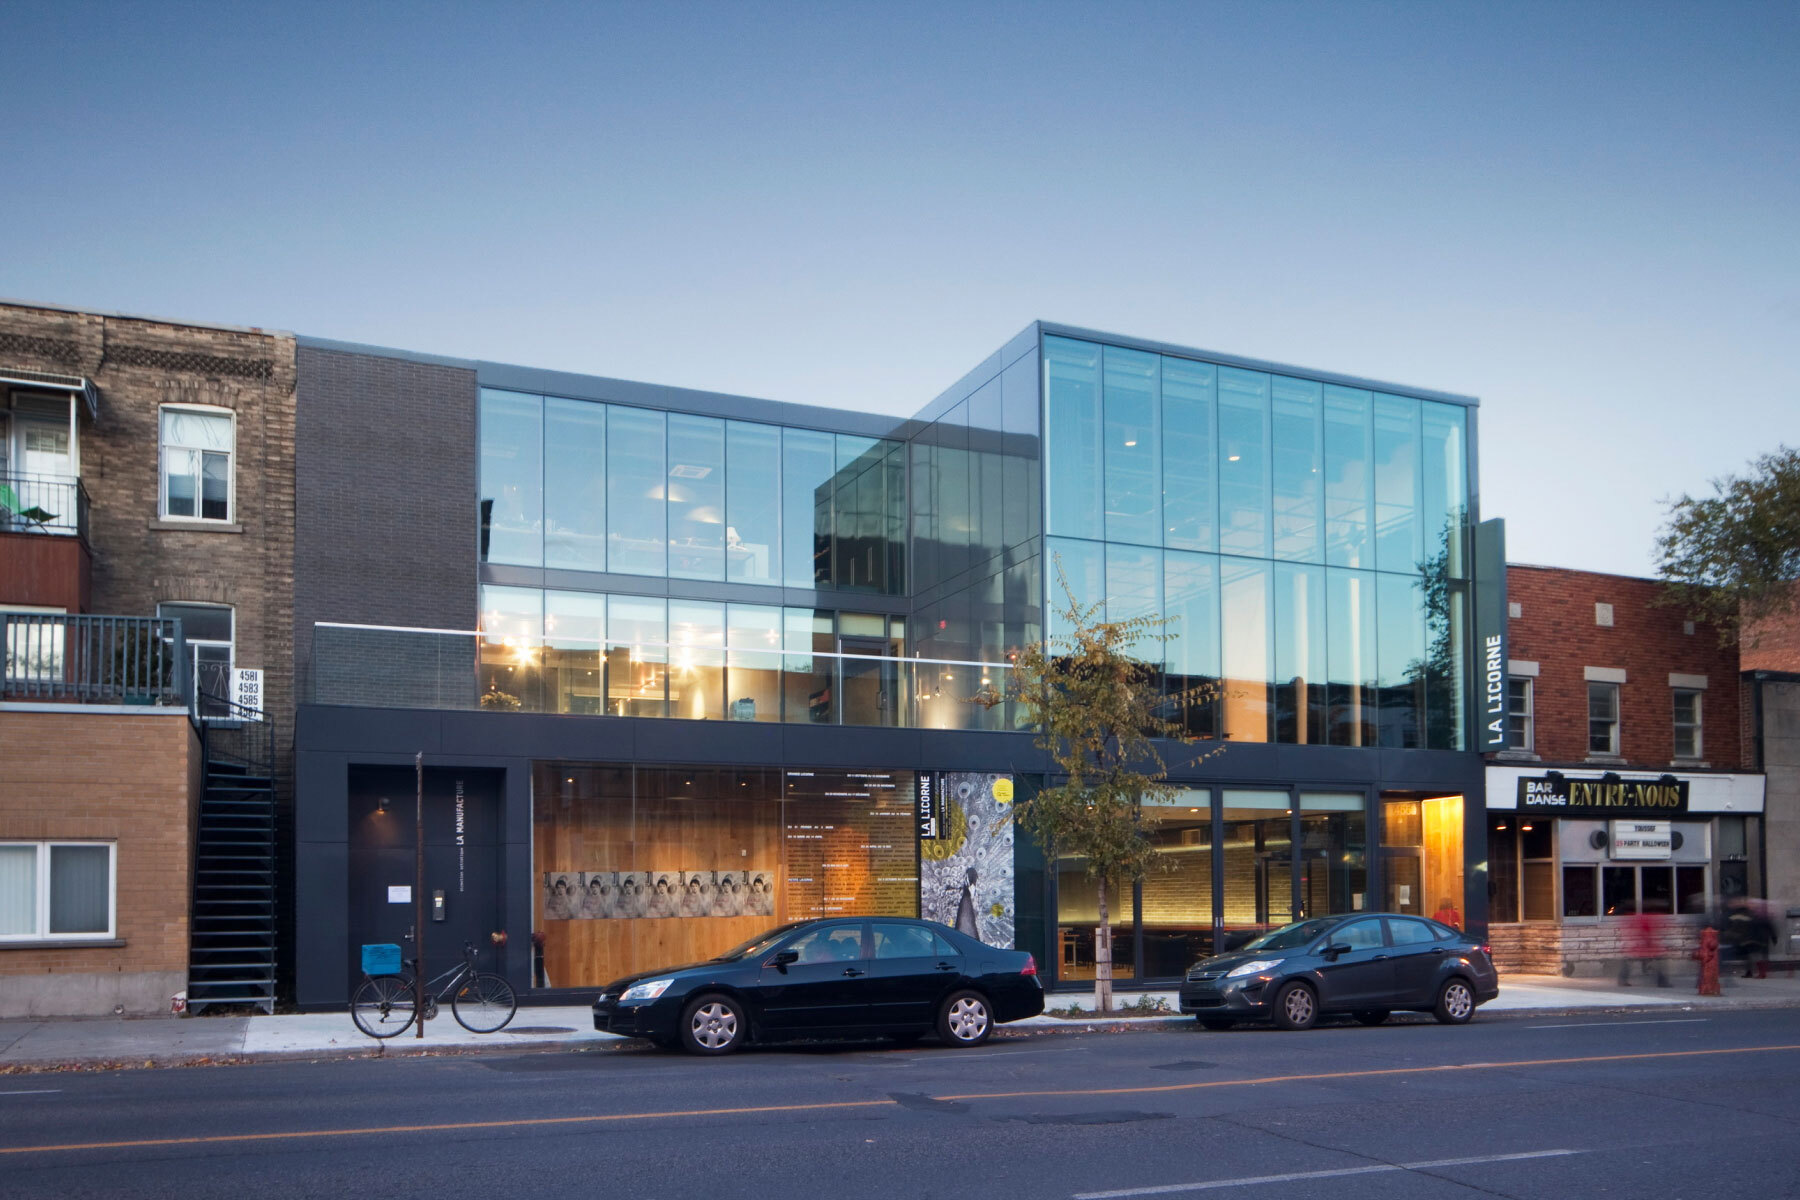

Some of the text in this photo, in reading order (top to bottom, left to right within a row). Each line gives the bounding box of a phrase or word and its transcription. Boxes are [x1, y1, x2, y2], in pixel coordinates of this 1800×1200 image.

[240, 670, 258, 682] 4581
[239, 682, 259, 694] 4583
[1486, 635, 1503, 744] LA LICORNE
[238, 694, 258, 706] 4585
[1526, 782, 1552, 792] BAR
[1526, 794, 1566, 805] DANSE
[1569, 782, 1680, 807] ENTRE-NOUS
[456, 780, 464, 833] MANUFACTURE
[920, 776, 930, 836] LA LICORNE
[456, 835, 464, 845] LA
